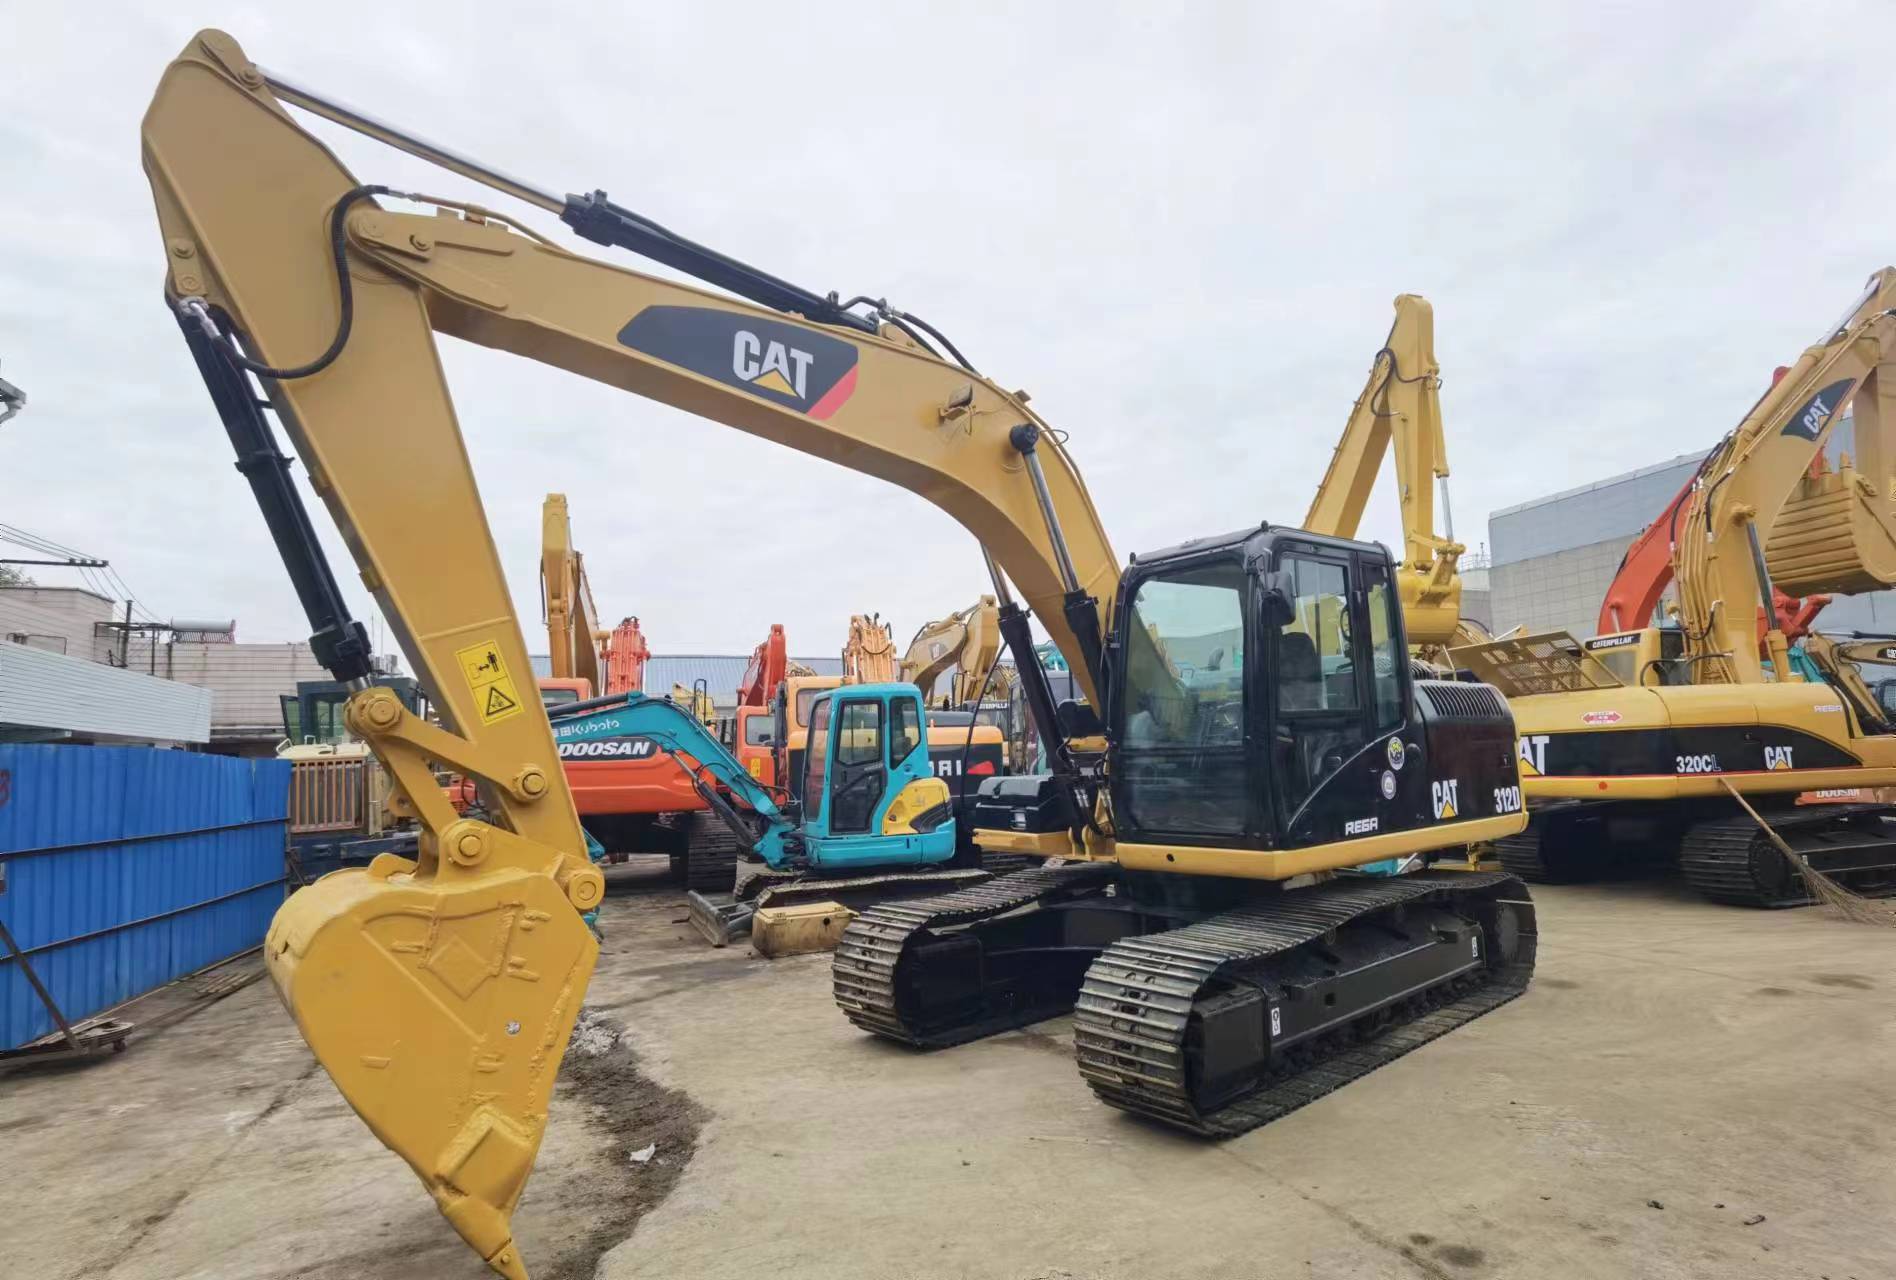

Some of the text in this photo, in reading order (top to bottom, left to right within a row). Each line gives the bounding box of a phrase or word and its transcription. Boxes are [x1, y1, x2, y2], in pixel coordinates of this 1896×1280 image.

[733, 330, 814, 400] CAT
[1803, 394, 1831, 434] CAT
[1592, 637, 1634, 648] CATERPILLAR
[571, 719, 620, 735] Kubota
[559, 742, 650, 757] DOOSAN
[1519, 736, 1550, 776] AT
[1764, 746, 1793, 770] CAT
[1432, 779, 1458, 819] CAT
[1494, 786, 1520, 813] 312D
